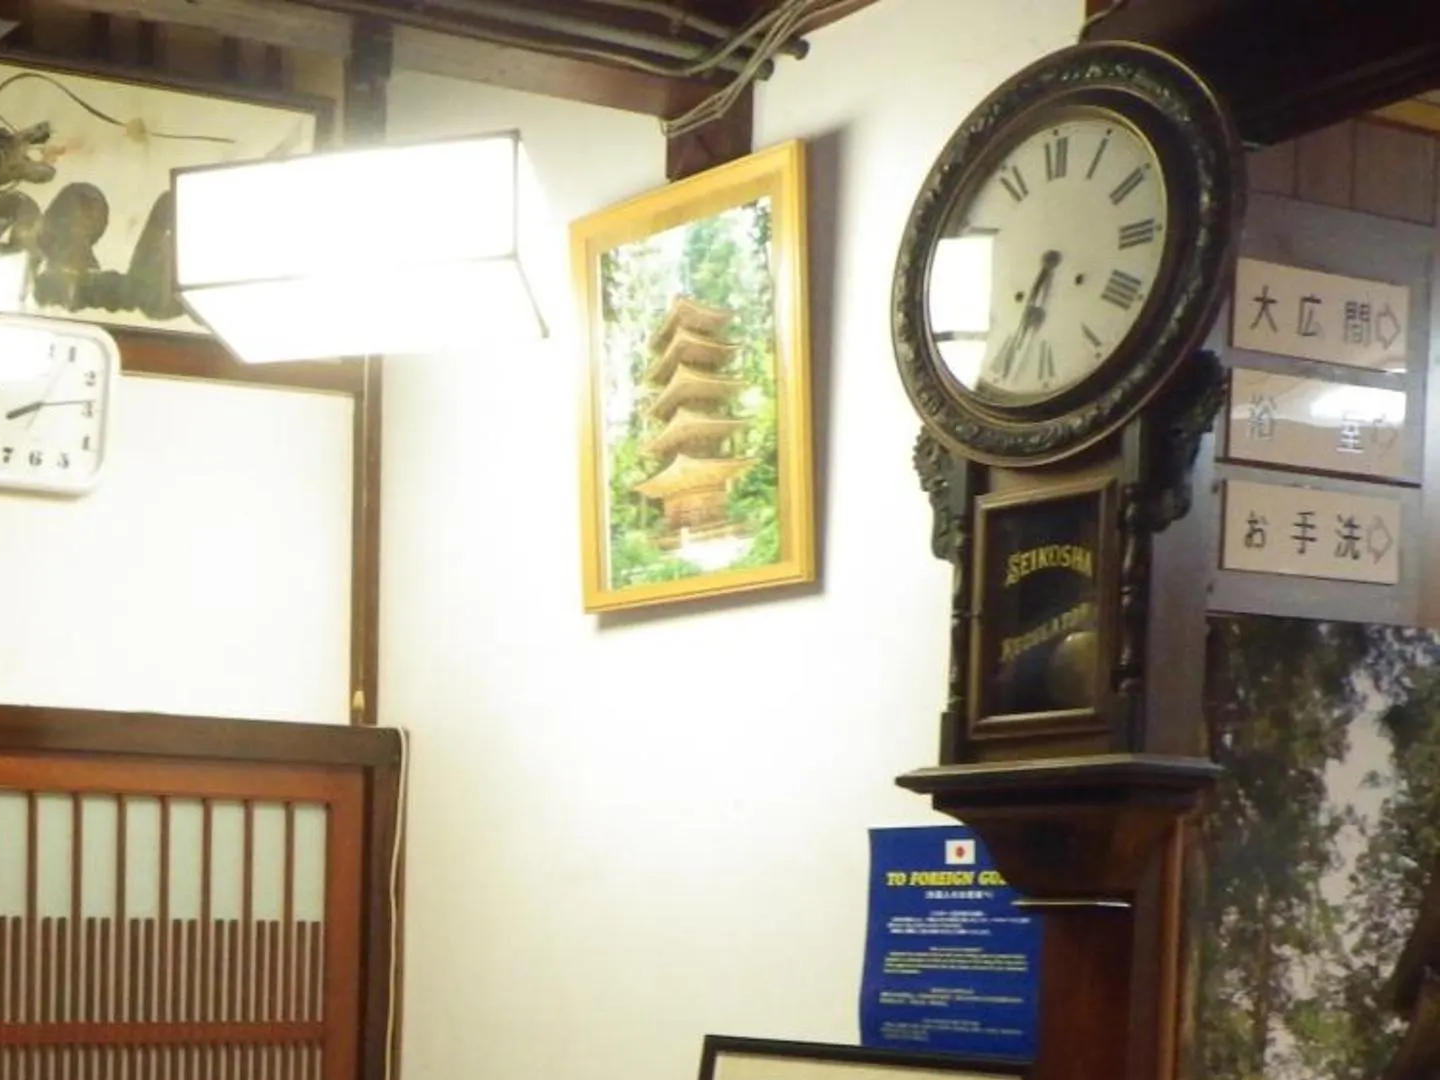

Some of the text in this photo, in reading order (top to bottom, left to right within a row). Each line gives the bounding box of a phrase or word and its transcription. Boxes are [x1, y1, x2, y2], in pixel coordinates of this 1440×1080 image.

[1250, 286, 1371, 347] 大広間
[28, 451, 43, 467] 6
[1243, 510, 1362, 560] お手洗
[1004, 544, 1093, 588] SEIKOSHA
[885, 870, 1007, 886] TO FOREIGN GU
